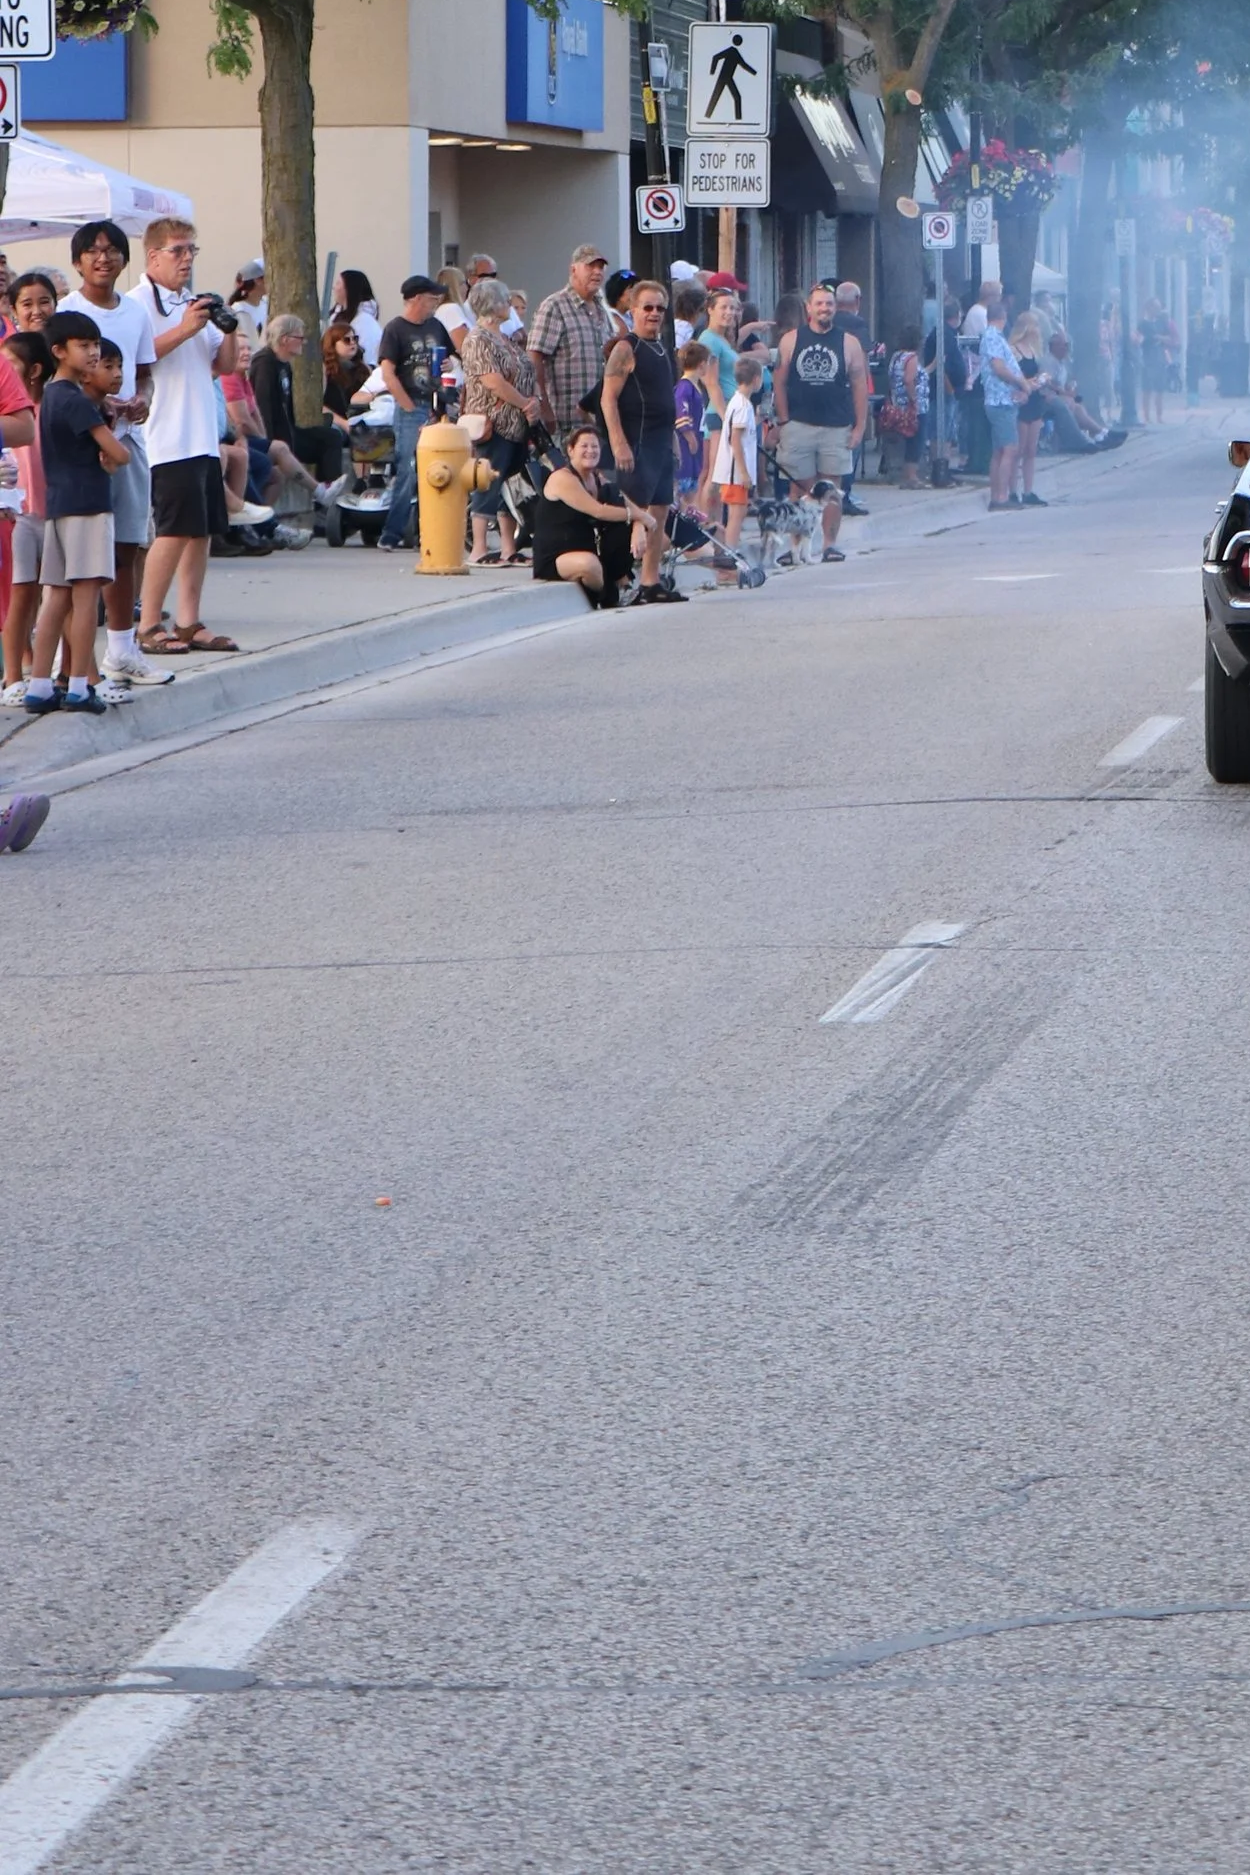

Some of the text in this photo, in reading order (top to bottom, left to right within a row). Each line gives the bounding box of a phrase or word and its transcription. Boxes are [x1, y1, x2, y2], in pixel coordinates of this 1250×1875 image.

[699, 153, 756, 169] STOP FOR
[692, 175, 762, 192] PEDESTRIANS
